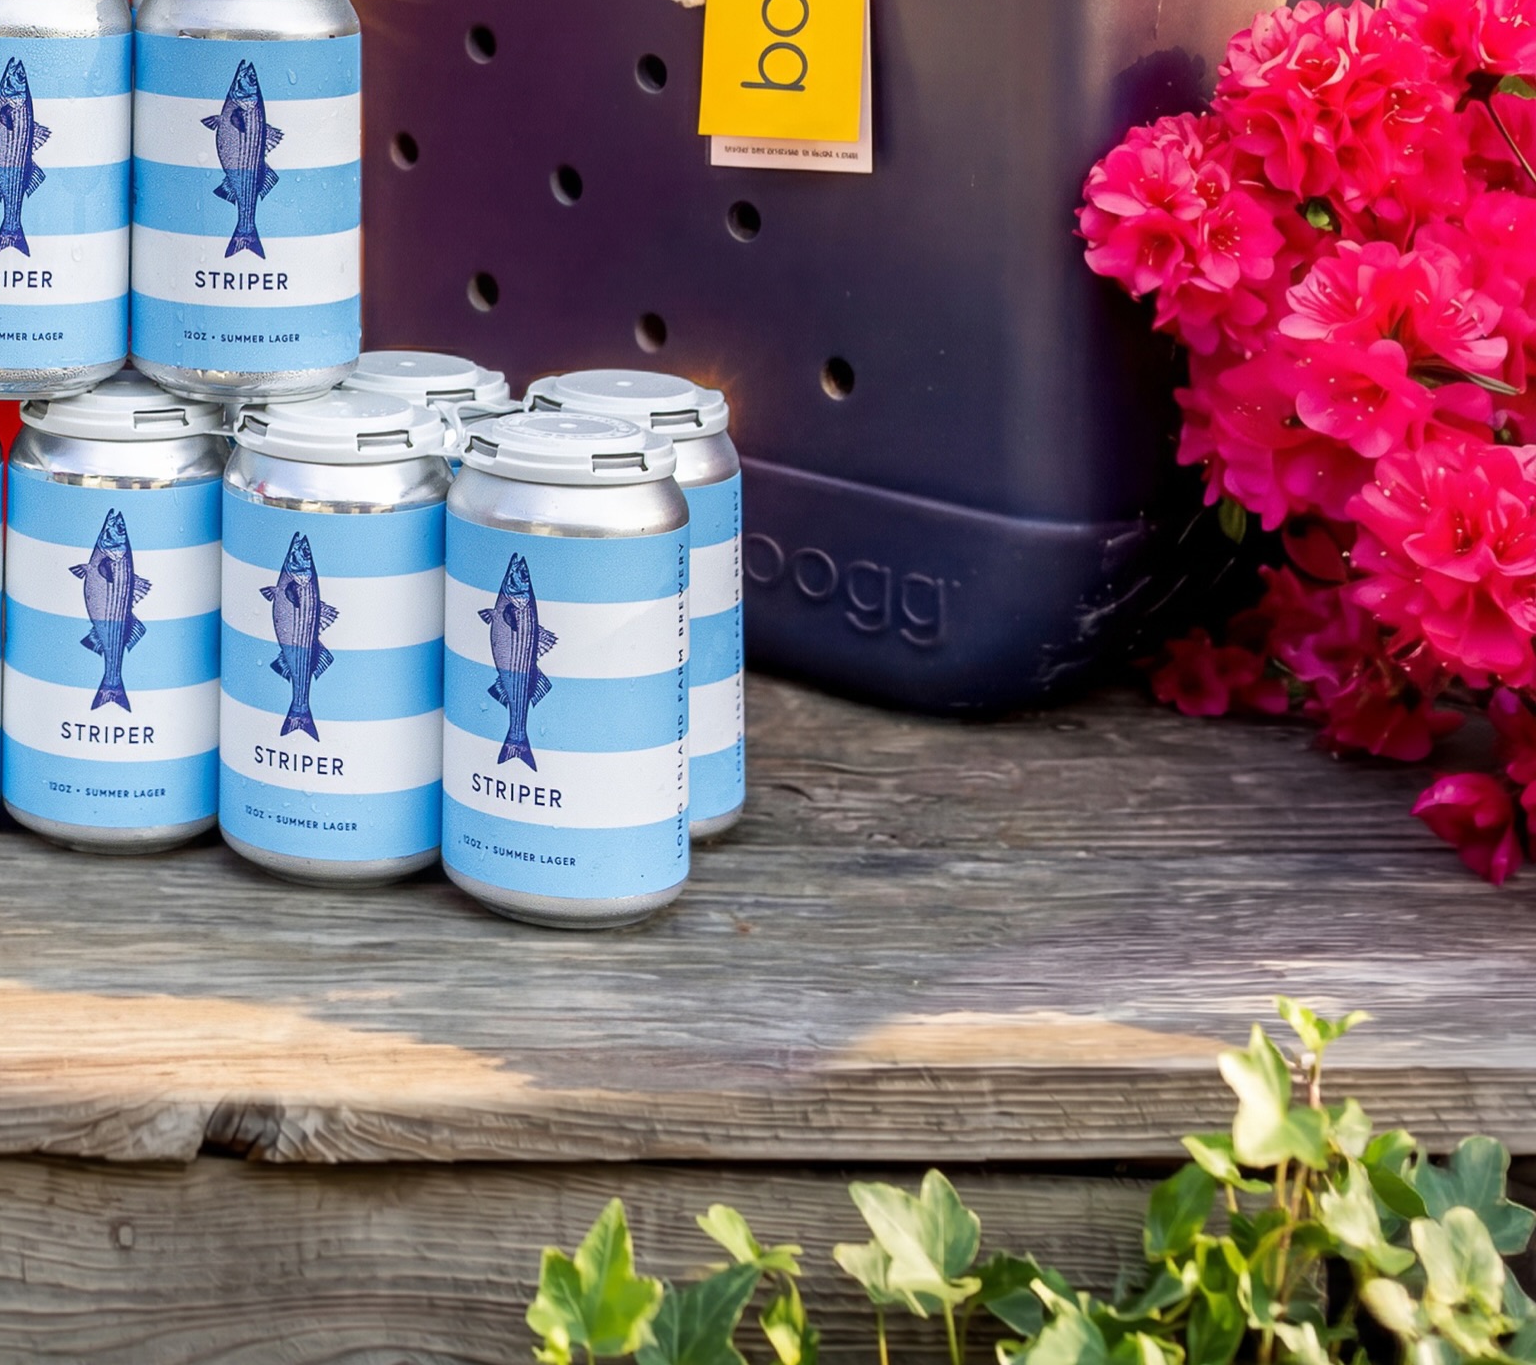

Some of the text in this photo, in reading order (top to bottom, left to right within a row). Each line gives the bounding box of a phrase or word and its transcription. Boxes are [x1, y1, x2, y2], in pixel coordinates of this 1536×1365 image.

[195, 270, 289, 291] STRIPER
[32, 331, 64, 341] LAGER
[184, 330, 300, 343] 12OZ SUMMER LAGER
[61, 722, 155, 745] STRIPER
[254, 745, 344, 776] STRIPER
[85, 788, 130, 798] SUMMER
[134, 788, 166, 798] LAGER
[472, 772, 562, 809] STRIPER
[276, 815, 319, 830] SUMMER
[323, 821, 358, 832] LAGER
[493, 846, 536, 863] SUMMER
[540, 855, 577, 867] LAGER
